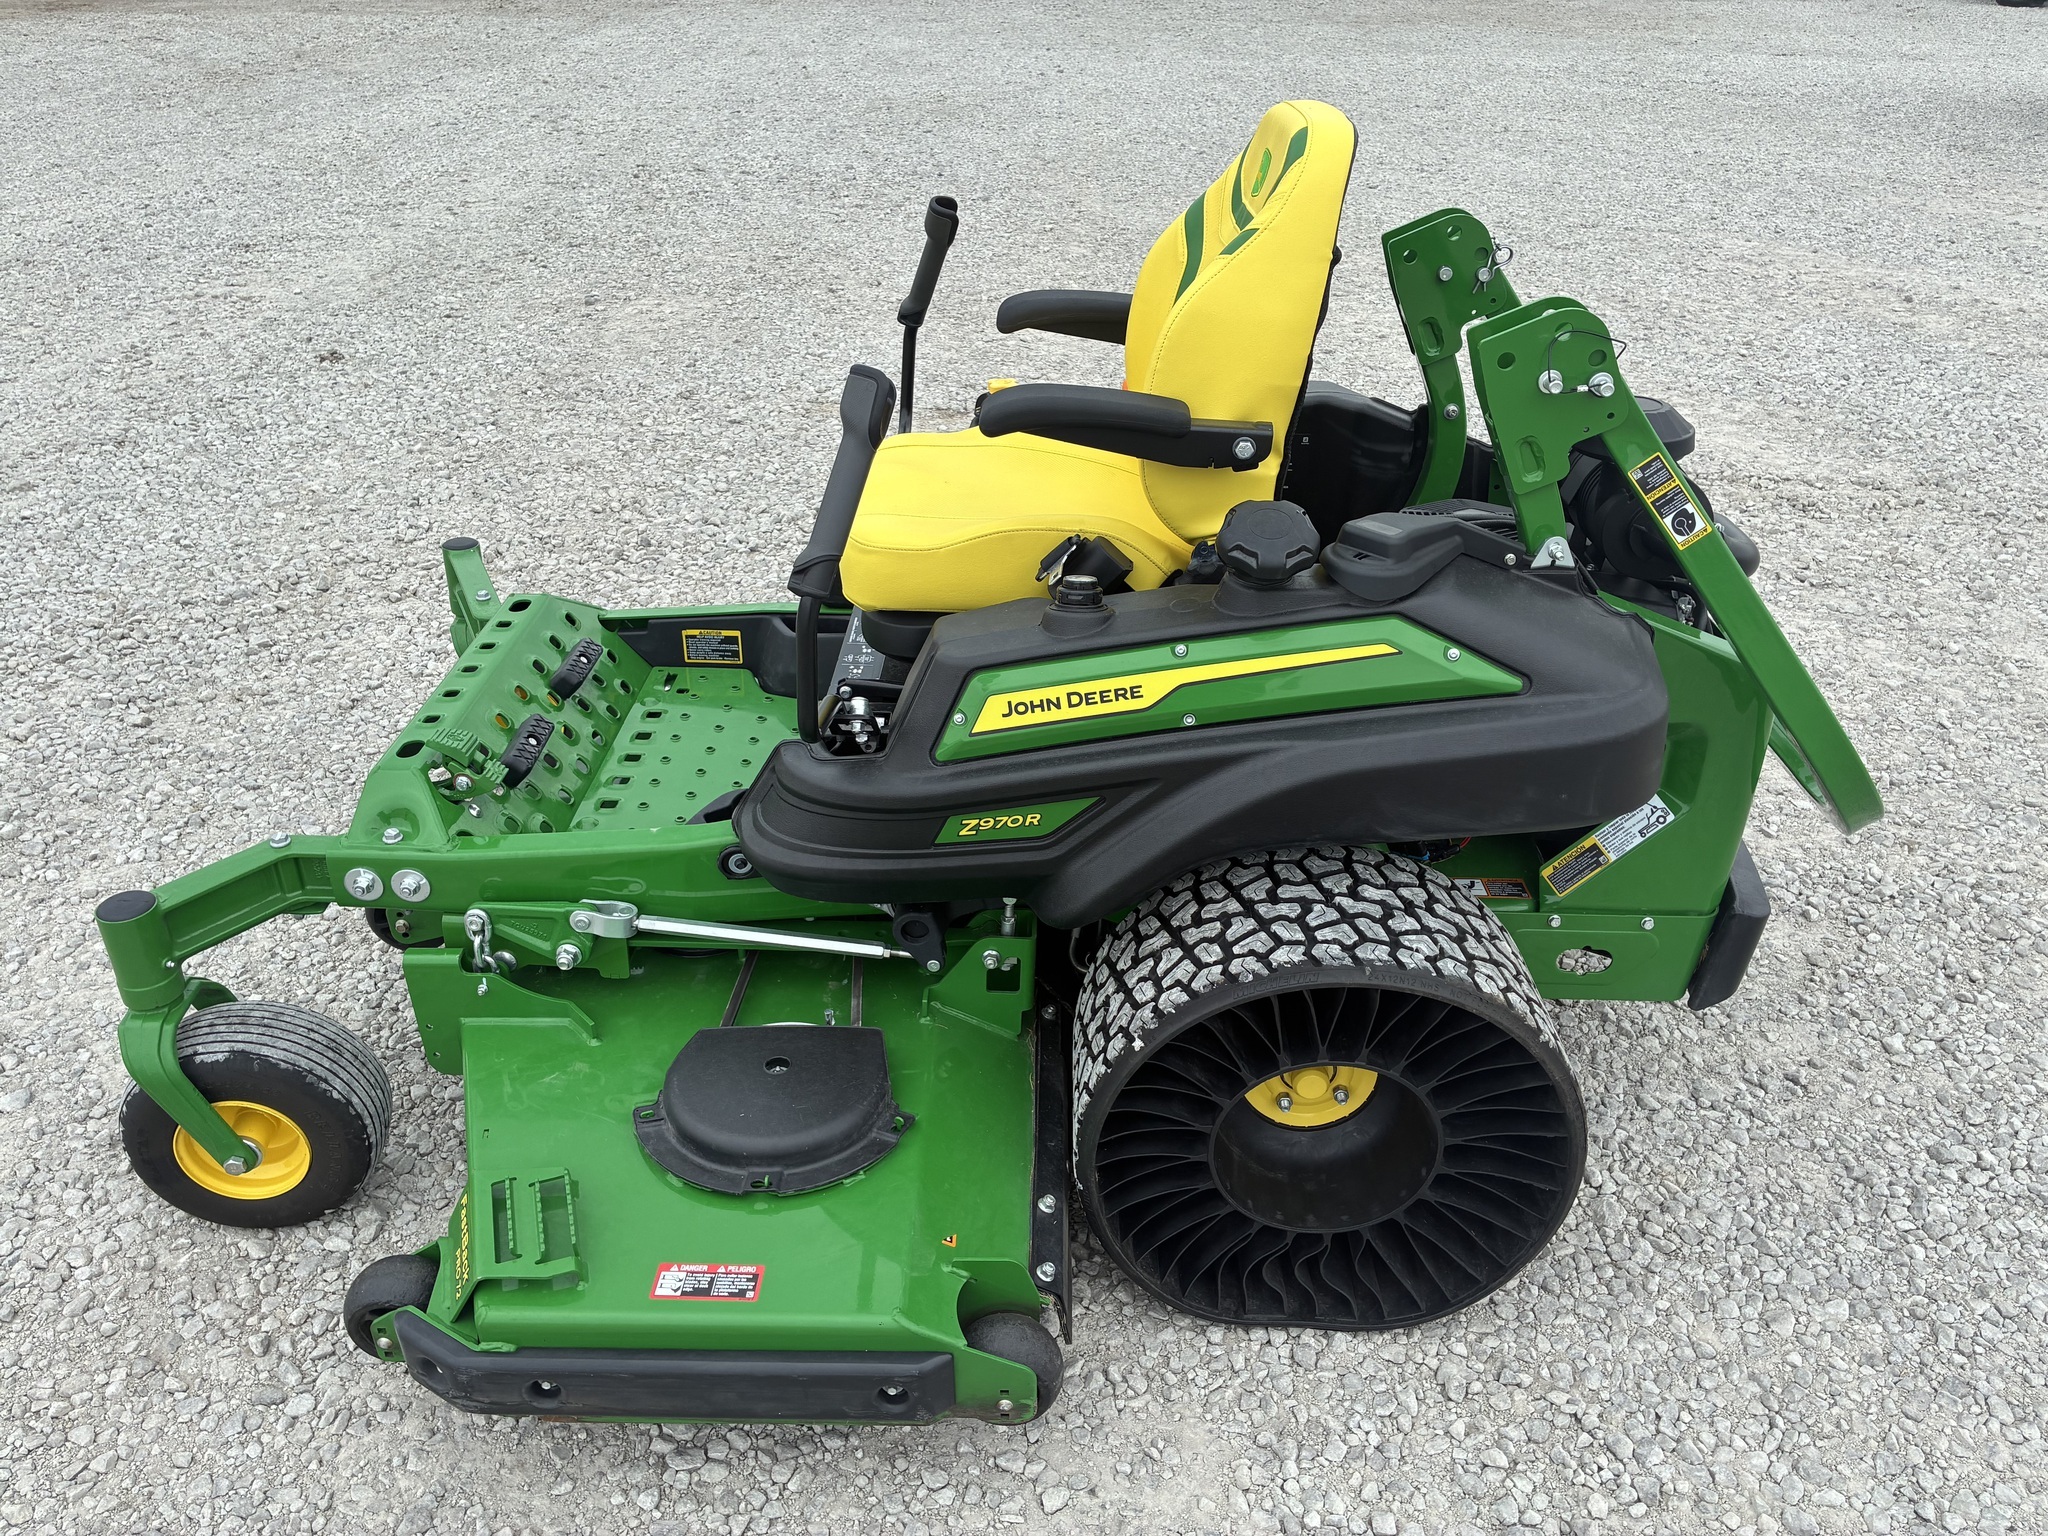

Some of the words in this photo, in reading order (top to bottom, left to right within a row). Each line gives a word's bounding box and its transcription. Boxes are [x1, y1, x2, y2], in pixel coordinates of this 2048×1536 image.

[1680, 530, 1705, 548] CAUTION
[1002, 696, 1062, 718] JOHN
[1066, 685, 1144, 709] DEERE
[958, 813, 1041, 836] Z970R
[1557, 845, 1586, 867] ATENCIÓN
[1232, 972, 1320, 1000] MICHELIN
[461, 1193, 470, 1286] FastBack
[727, 1265, 757, 1273] PELIGRO
[455, 1280, 462, 1300] 72
